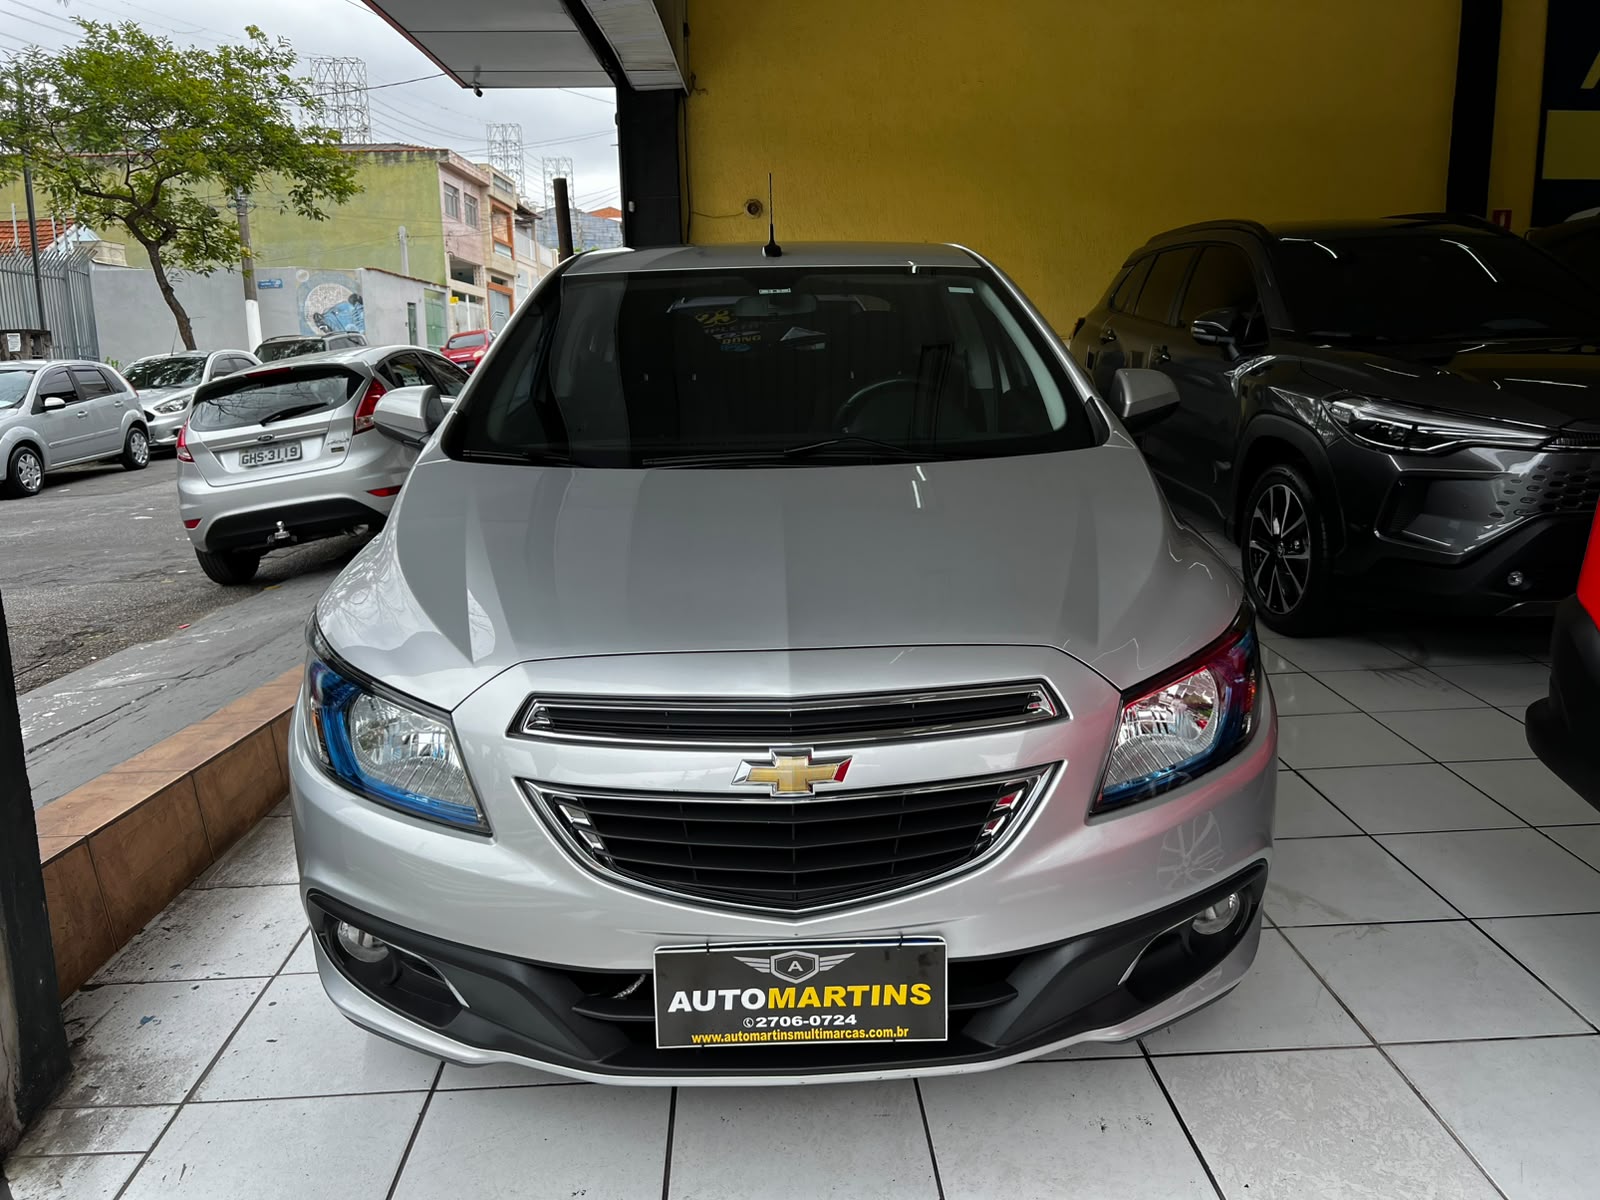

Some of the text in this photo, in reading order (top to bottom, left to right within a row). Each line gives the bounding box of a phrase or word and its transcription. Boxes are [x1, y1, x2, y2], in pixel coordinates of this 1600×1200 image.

[787, 960, 804, 972] A
[667, 983, 932, 1013] AUTOMARTINS
[755, 1014, 857, 1028] 2706-0724
[691, 1026, 909, 1043] www.automartinsmultimarcas.com.br
